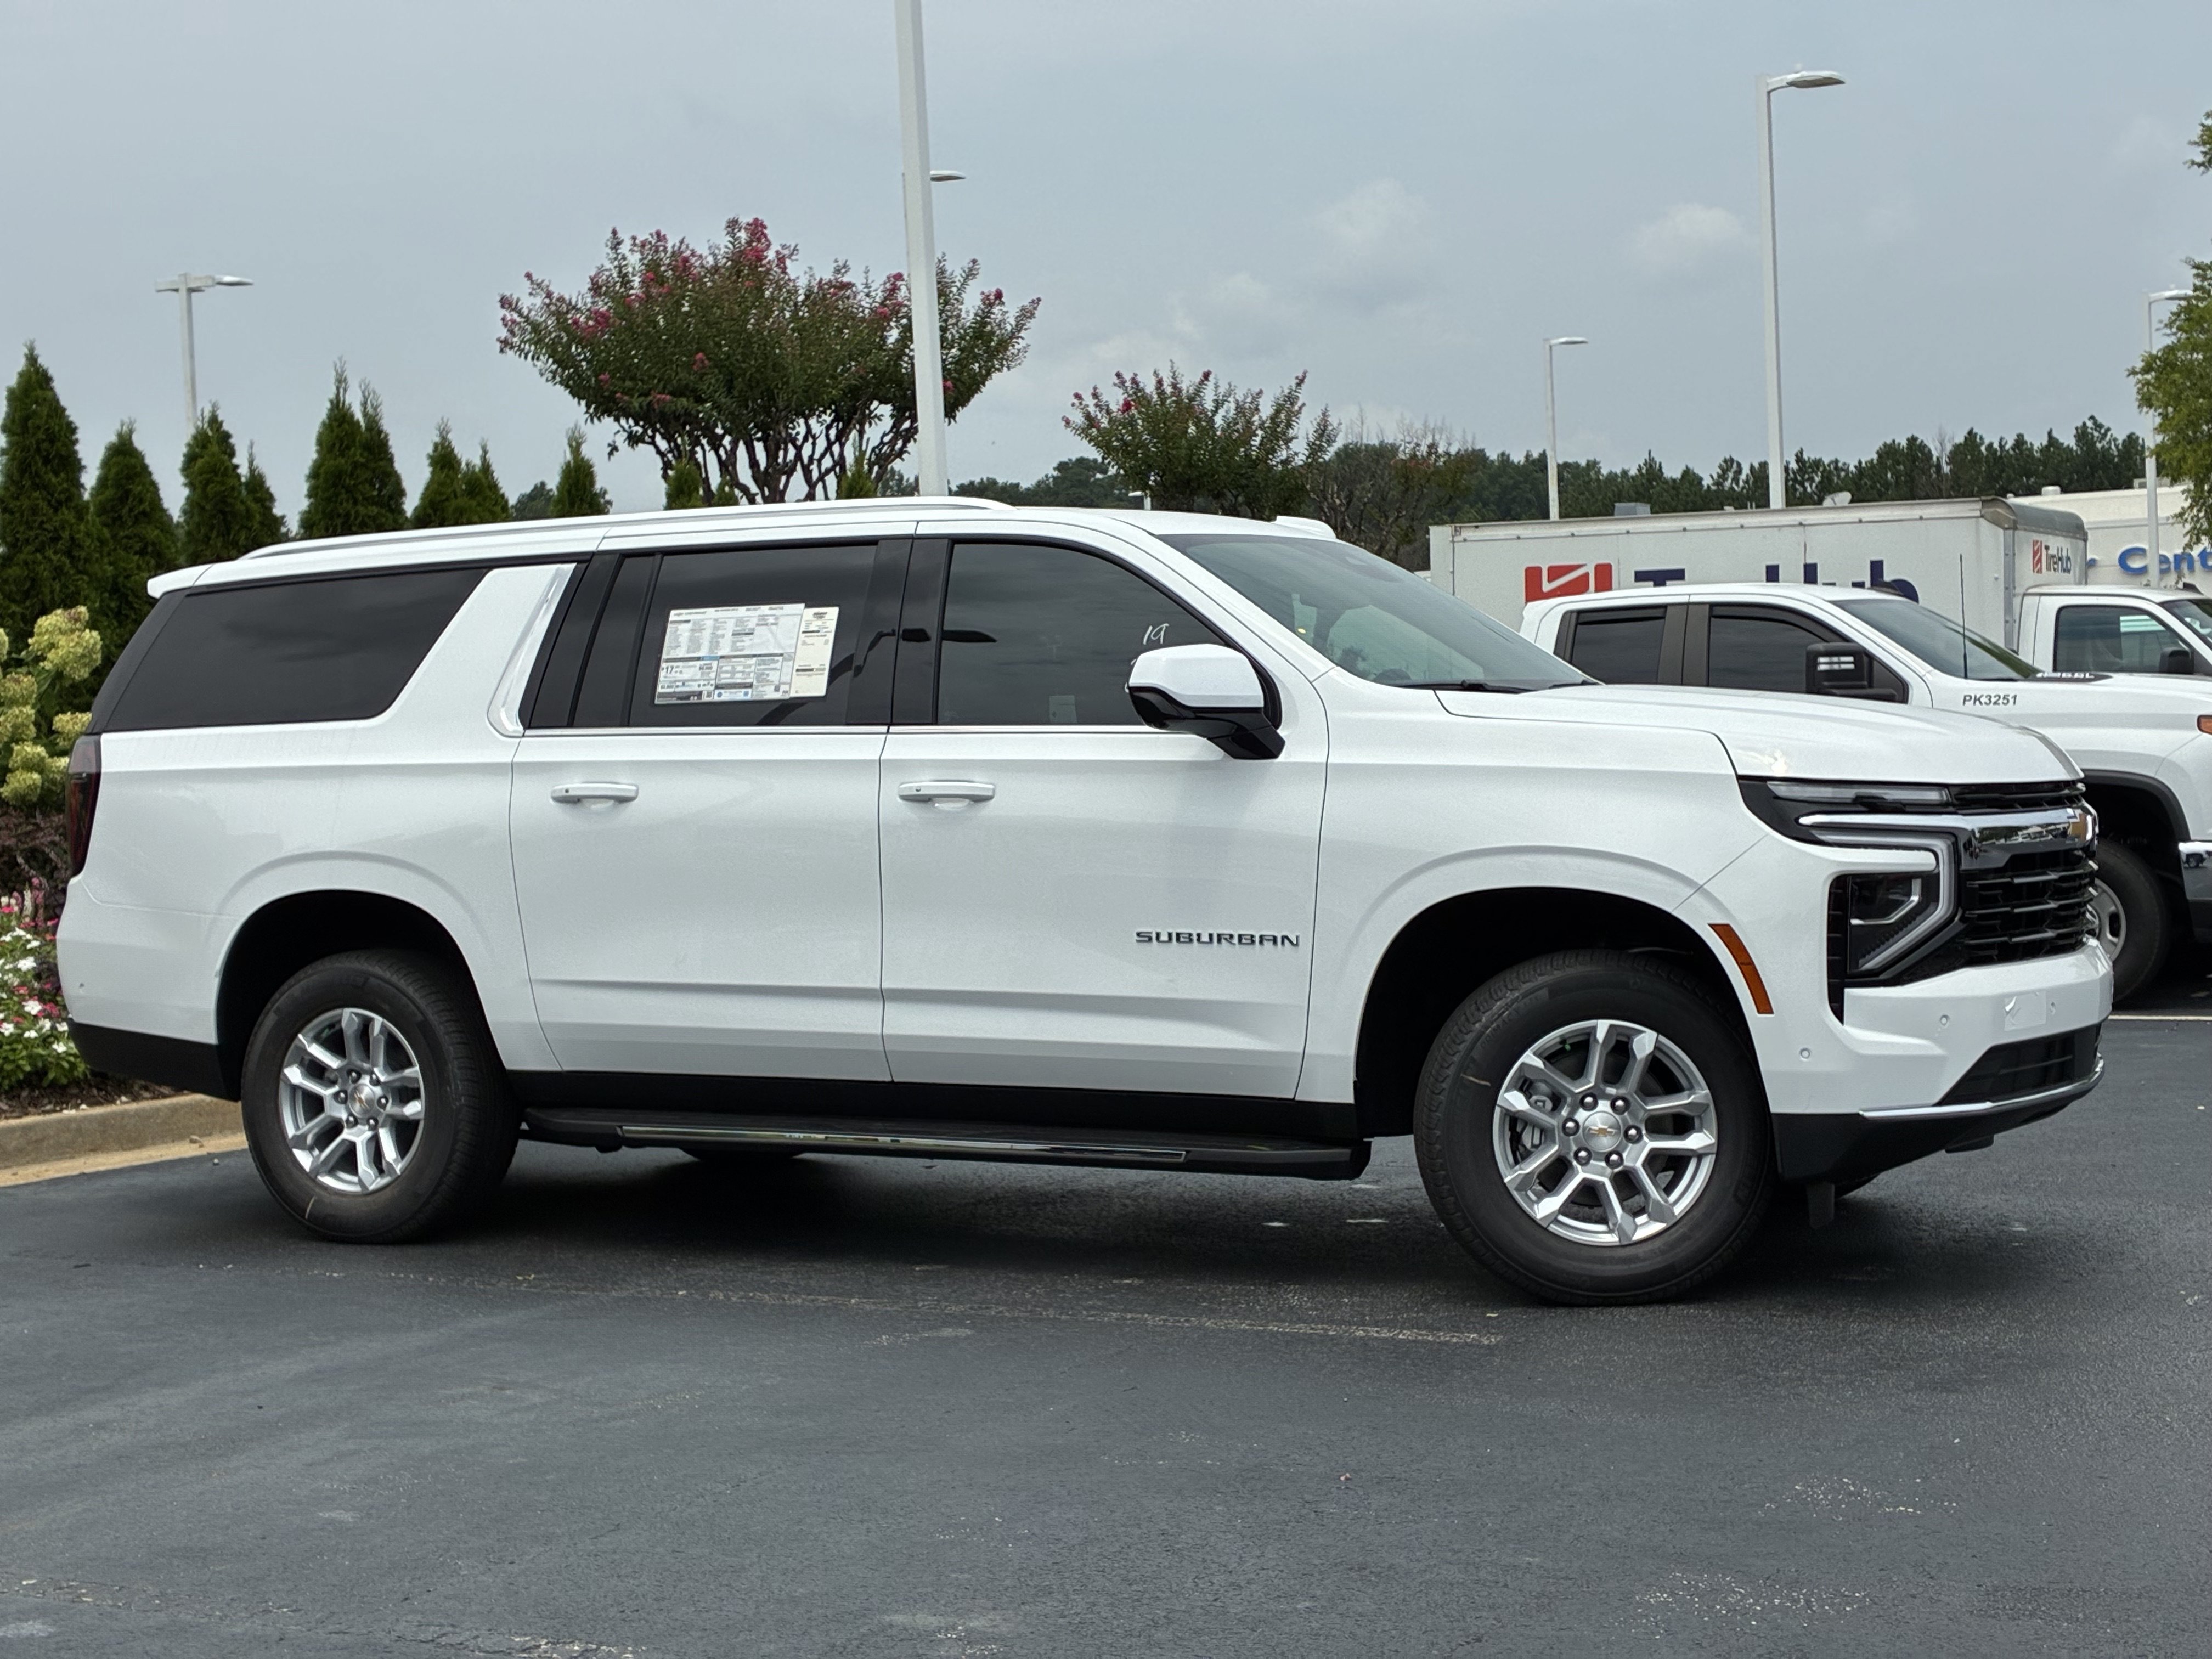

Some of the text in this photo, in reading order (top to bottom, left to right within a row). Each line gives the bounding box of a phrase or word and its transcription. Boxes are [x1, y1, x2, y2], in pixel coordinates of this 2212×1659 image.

[2044, 545, 2072, 574] TireHub
[1143, 623, 1170, 645] 19
[1962, 694, 2017, 706] PK3251
[1136, 932, 1299, 947] SUBURBAN
